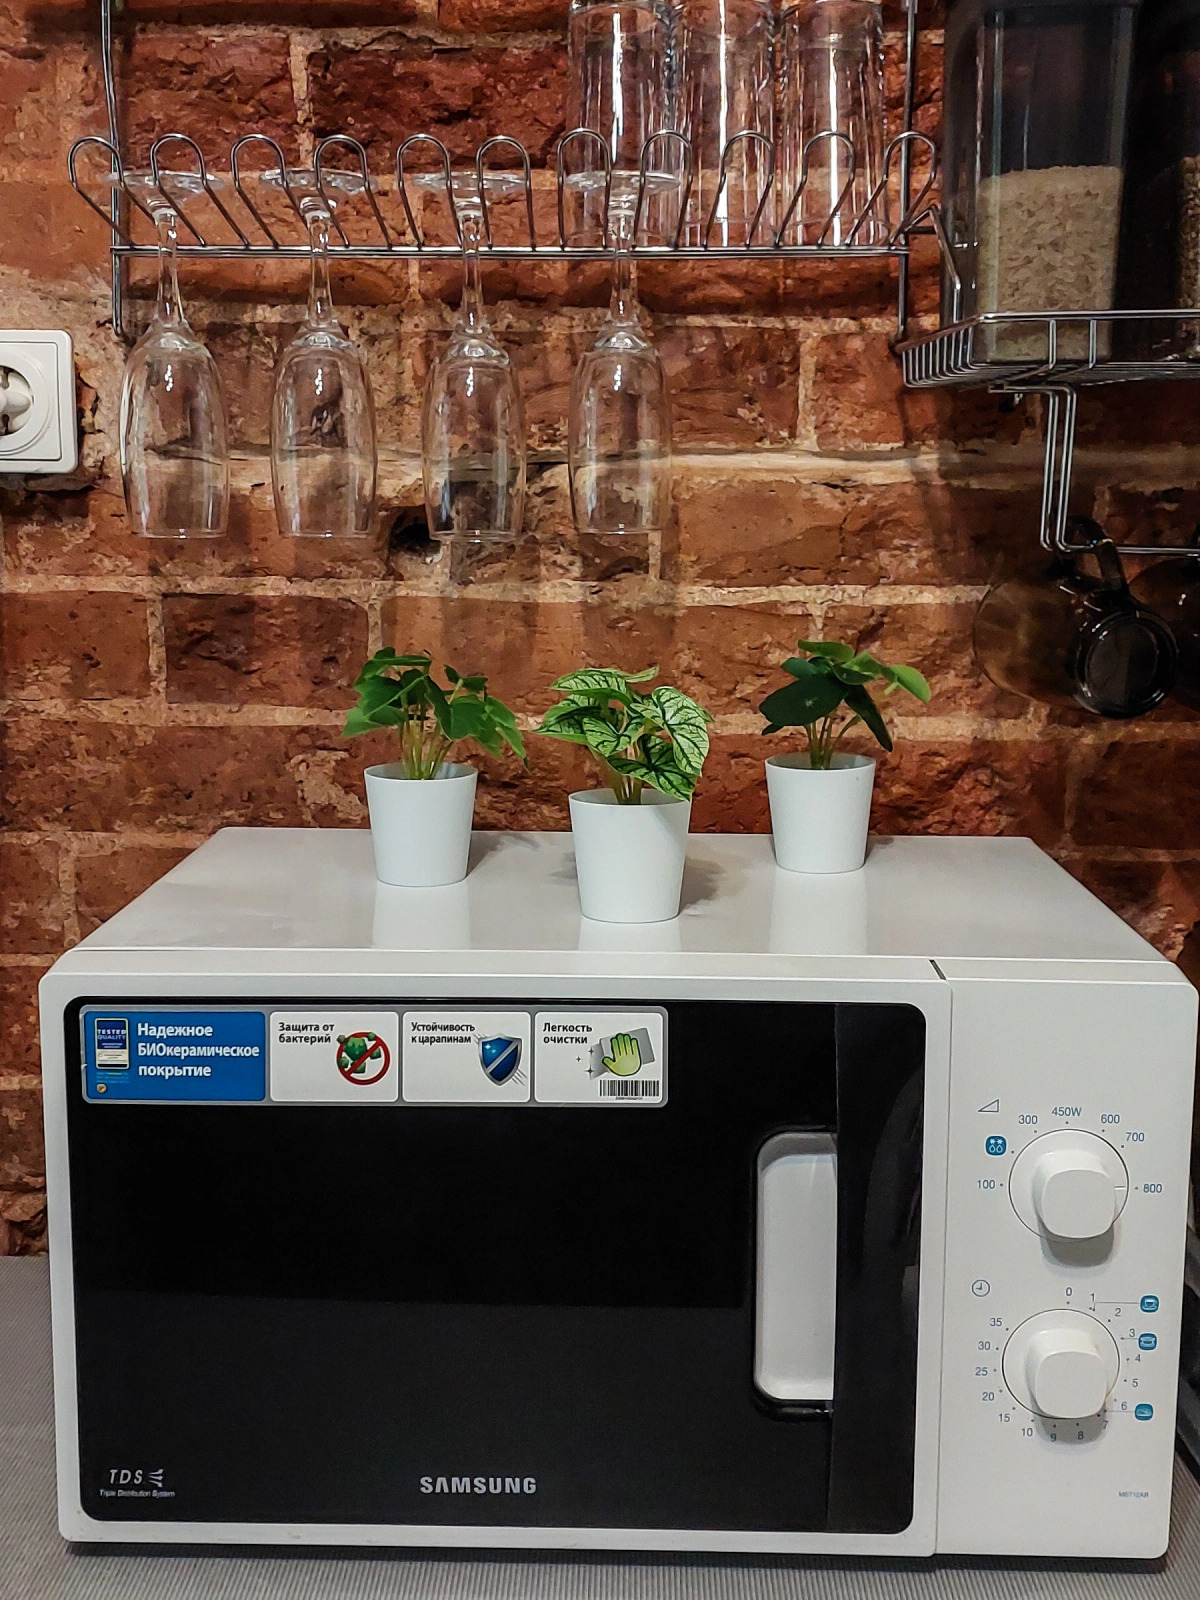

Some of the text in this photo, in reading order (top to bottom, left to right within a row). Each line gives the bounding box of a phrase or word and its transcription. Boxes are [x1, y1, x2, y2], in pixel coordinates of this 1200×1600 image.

[137, 1022, 213, 1038] Надежное
[278, 1022, 335, 1034] Защита от
[411, 1021, 475, 1033] Устойчивость
[542, 1022, 593, 1033] Легкость
[278, 1032, 332, 1045] бактерий
[411, 1035, 472, 1046] к царапинам
[543, 1035, 588, 1044] очистки
[137, 1043, 260, 1061] БИОкерамическое
[138, 1065, 212, 1080] покрытие
[1051, 1106, 1082, 1117] 450W
[1018, 1114, 1038, 1125] 300
[1100, 1114, 1121, 1124] 600
[1125, 1132, 1145, 1142] 700
[976, 1179, 996, 1190] 100
[1142, 1183, 1163, 1194] 800
[1065, 1286, 1073, 1297] 0
[1090, 1292, 1096, 1302] 1
[1114, 1307, 1122, 1317] 2
[989, 1317, 1003, 1327] 35
[1128, 1328, 1136, 1338] 3
[977, 1341, 991, 1351] 30
[1134, 1353, 1142, 1363] 4
[974, 1366, 988, 1377] 25
[1131, 1378, 1139, 1388] 5
[981, 1391, 995, 1402] 20
[1121, 1401, 1128, 1411] 6
[998, 1413, 1011, 1423] 15
[1102, 1419, 1109, 1430] 7
[1021, 1427, 1034, 1437] 10
[1050, 1432, 1057, 1443] 9
[1077, 1430, 1084, 1440] 8
[420, 1476, 537, 1494] SAMSUNG
